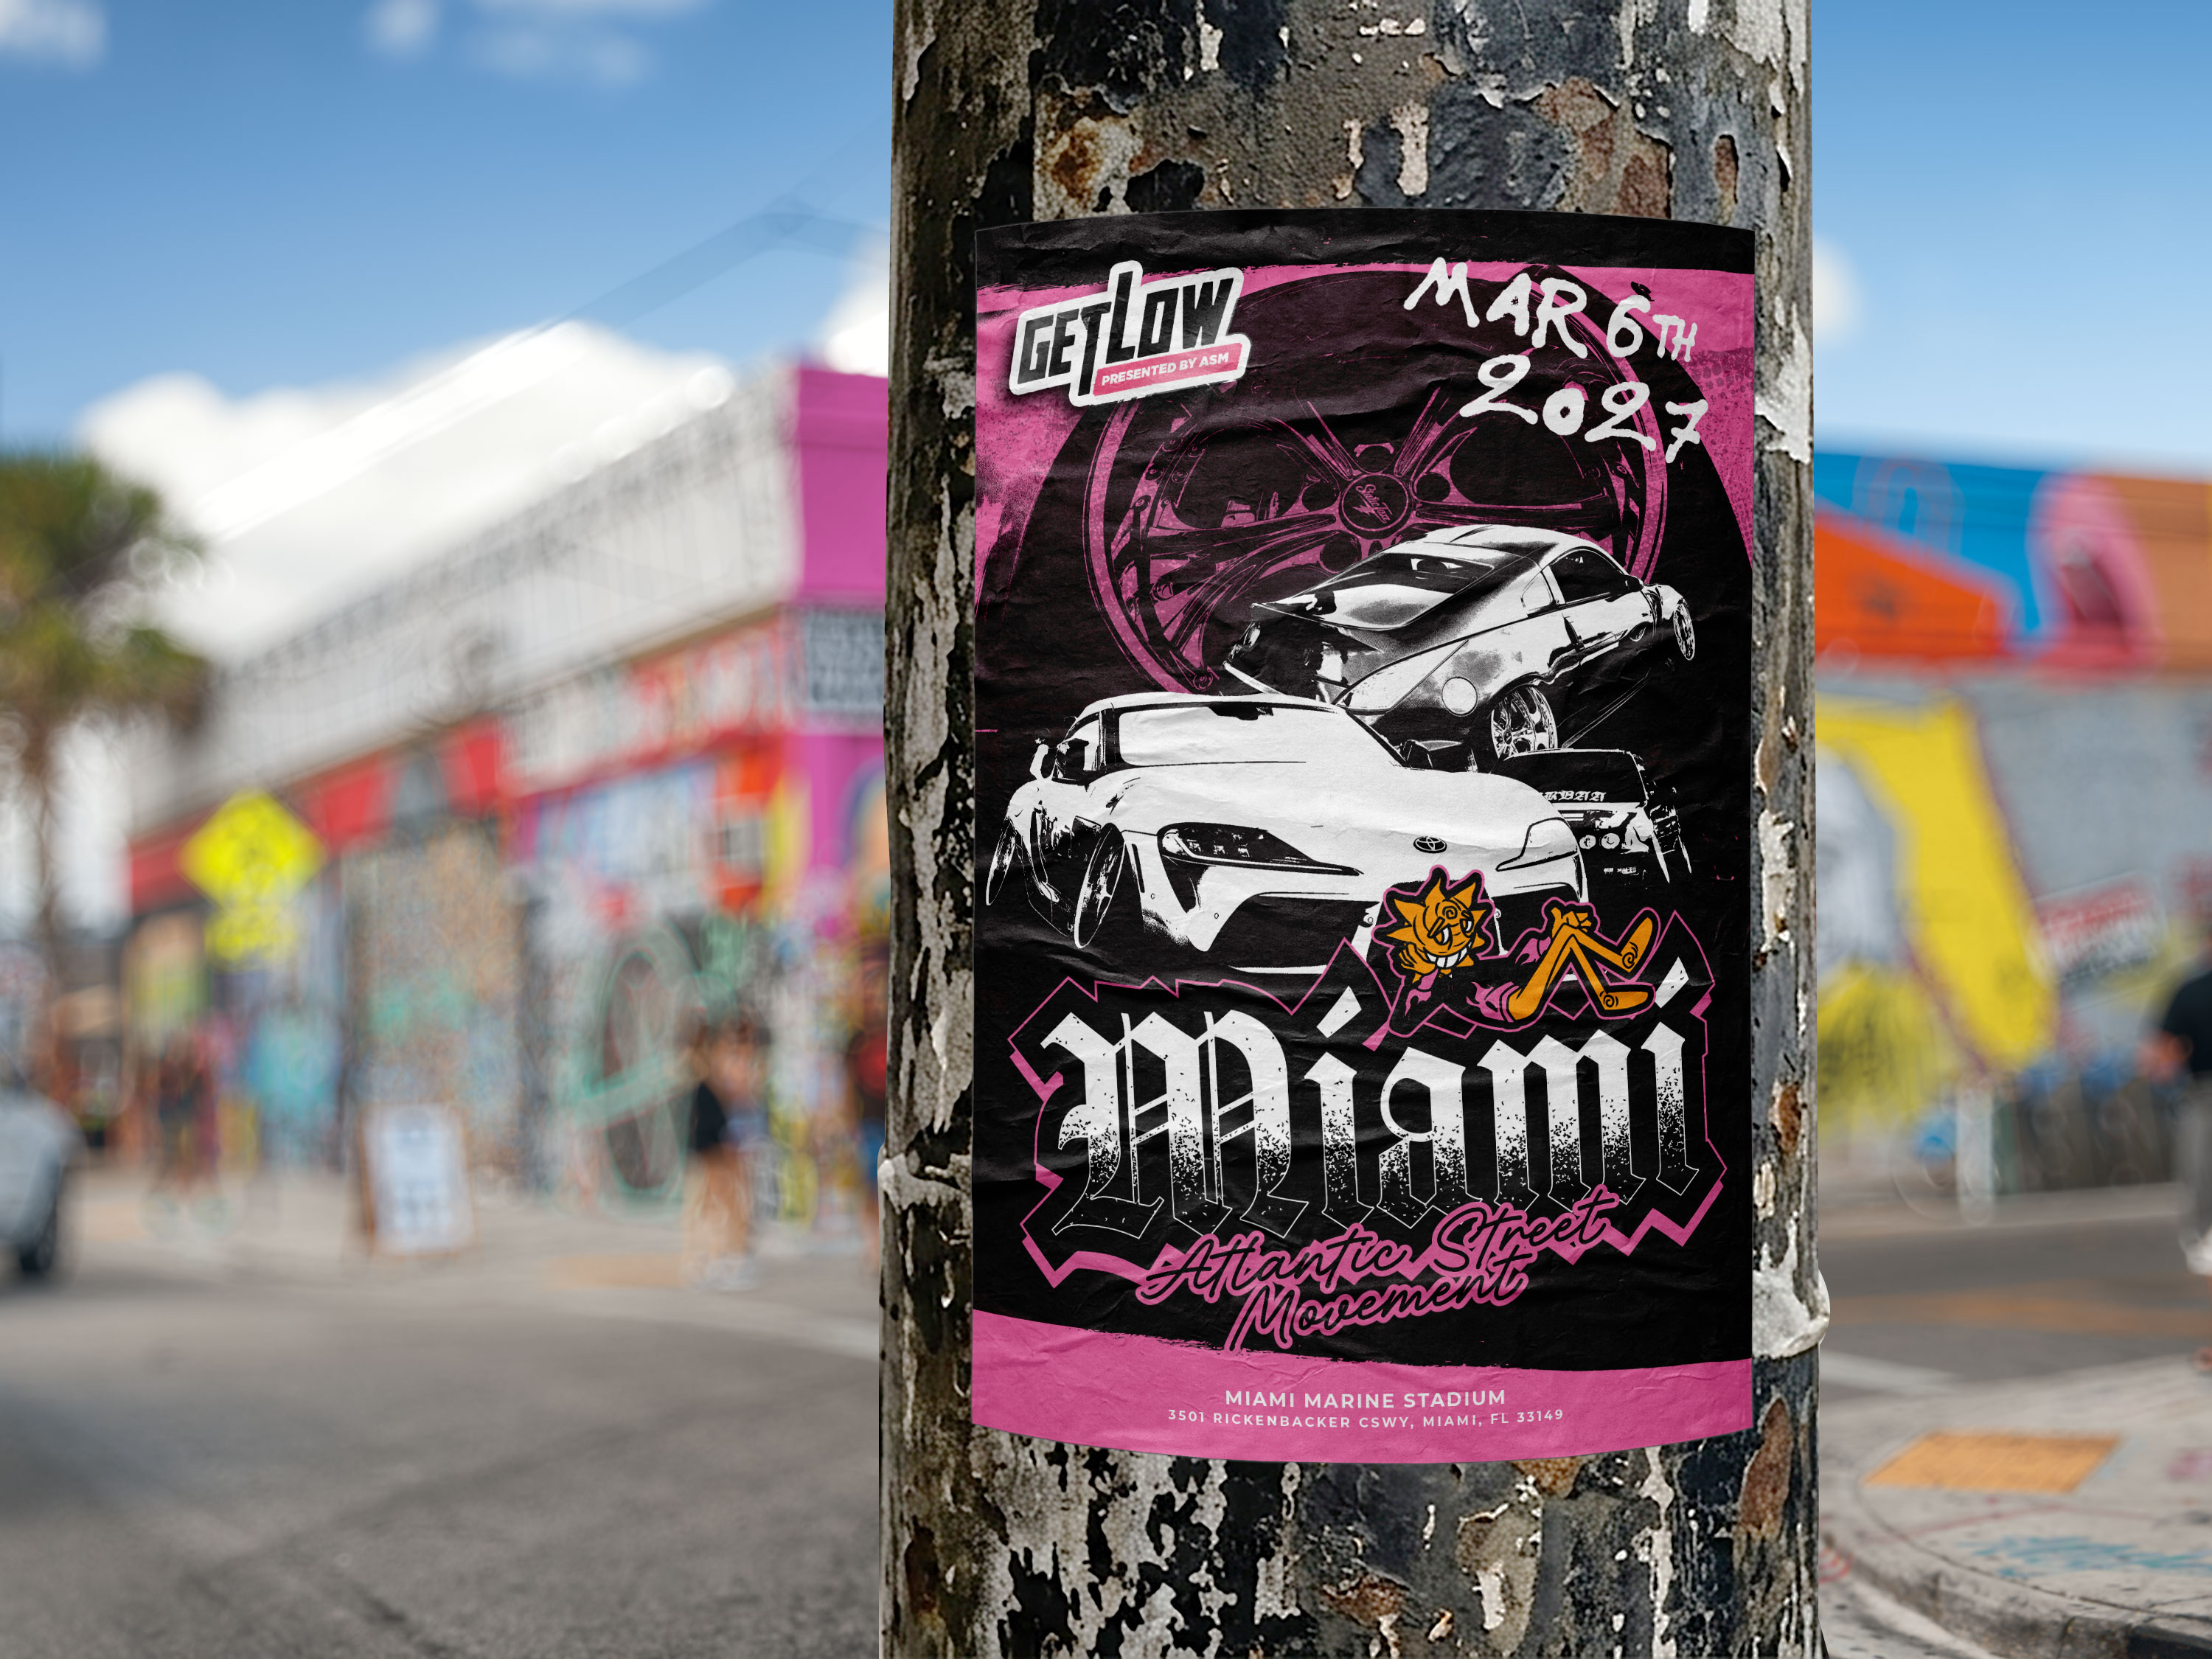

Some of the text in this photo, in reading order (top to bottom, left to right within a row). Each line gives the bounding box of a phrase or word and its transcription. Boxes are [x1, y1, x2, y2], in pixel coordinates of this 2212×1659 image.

[1403, 257, 1587, 358] MAR
[1101, 352, 1229, 386] PRESENTED BY ASM
[1459, 354, 1709, 463] 2027
[1040, 956, 1699, 1239] Miami
[1138, 1189, 1616, 1301] Atlantic Street
[1229, 1244, 1526, 1352] Movement
[1168, 1408, 1563, 1430] 3501 RICKENBACKER CSWY, MIAMI, FL 33149
[1225, 1389, 1506, 1409] MIAMI MARINE STADIUM
